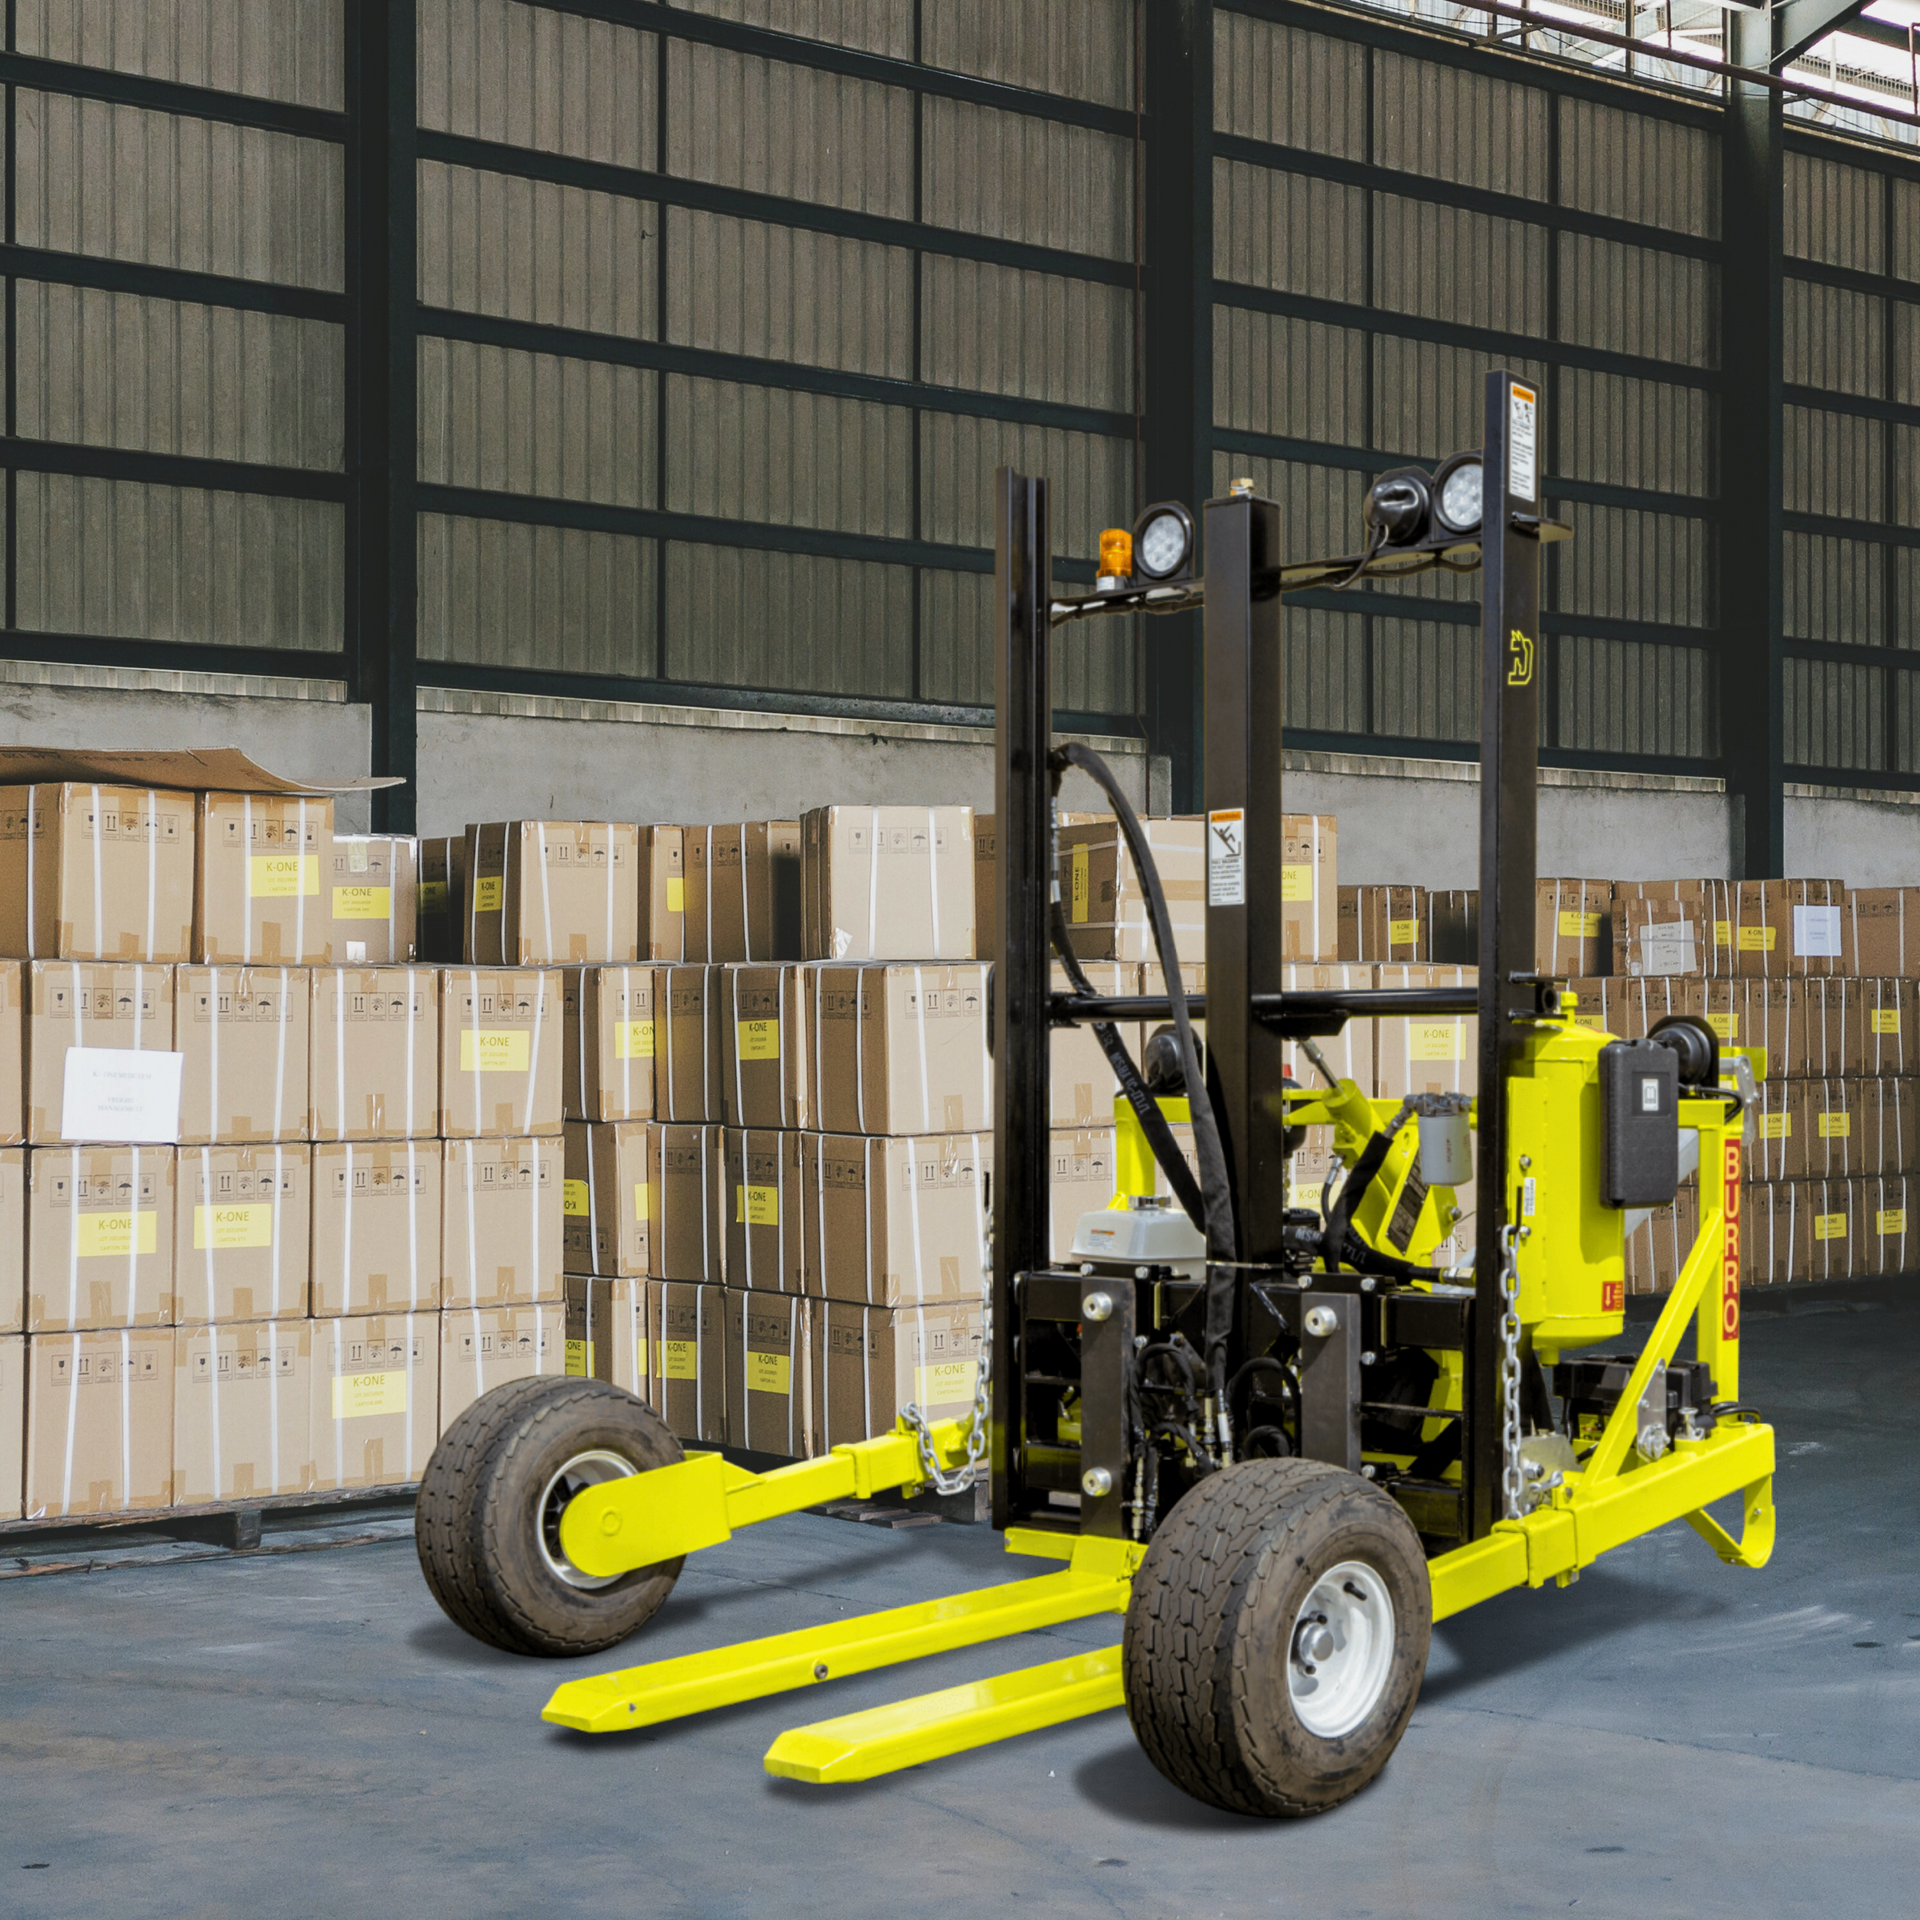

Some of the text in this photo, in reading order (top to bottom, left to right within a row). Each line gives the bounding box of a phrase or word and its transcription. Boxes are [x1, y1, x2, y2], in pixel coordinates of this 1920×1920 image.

[267, 861, 299, 872] K-ONE
[342, 888, 372, 897] K-ONE
[749, 1022, 767, 1032] K-ONE
[1423, 1029, 1450, 1039] K-ONE
[480, 1036, 510, 1047] K-ONE
[216, 1211, 249, 1223] K-ONE
[98, 1218, 132, 1230] K-ONE
[1724, 1146, 1740, 1333] BURRO
[667, 1342, 687, 1353] K-ONE
[758, 1354, 778, 1366] K-ONE
[934, 1363, 965, 1377] K-ONE
[353, 1374, 386, 1387] K-ONE
